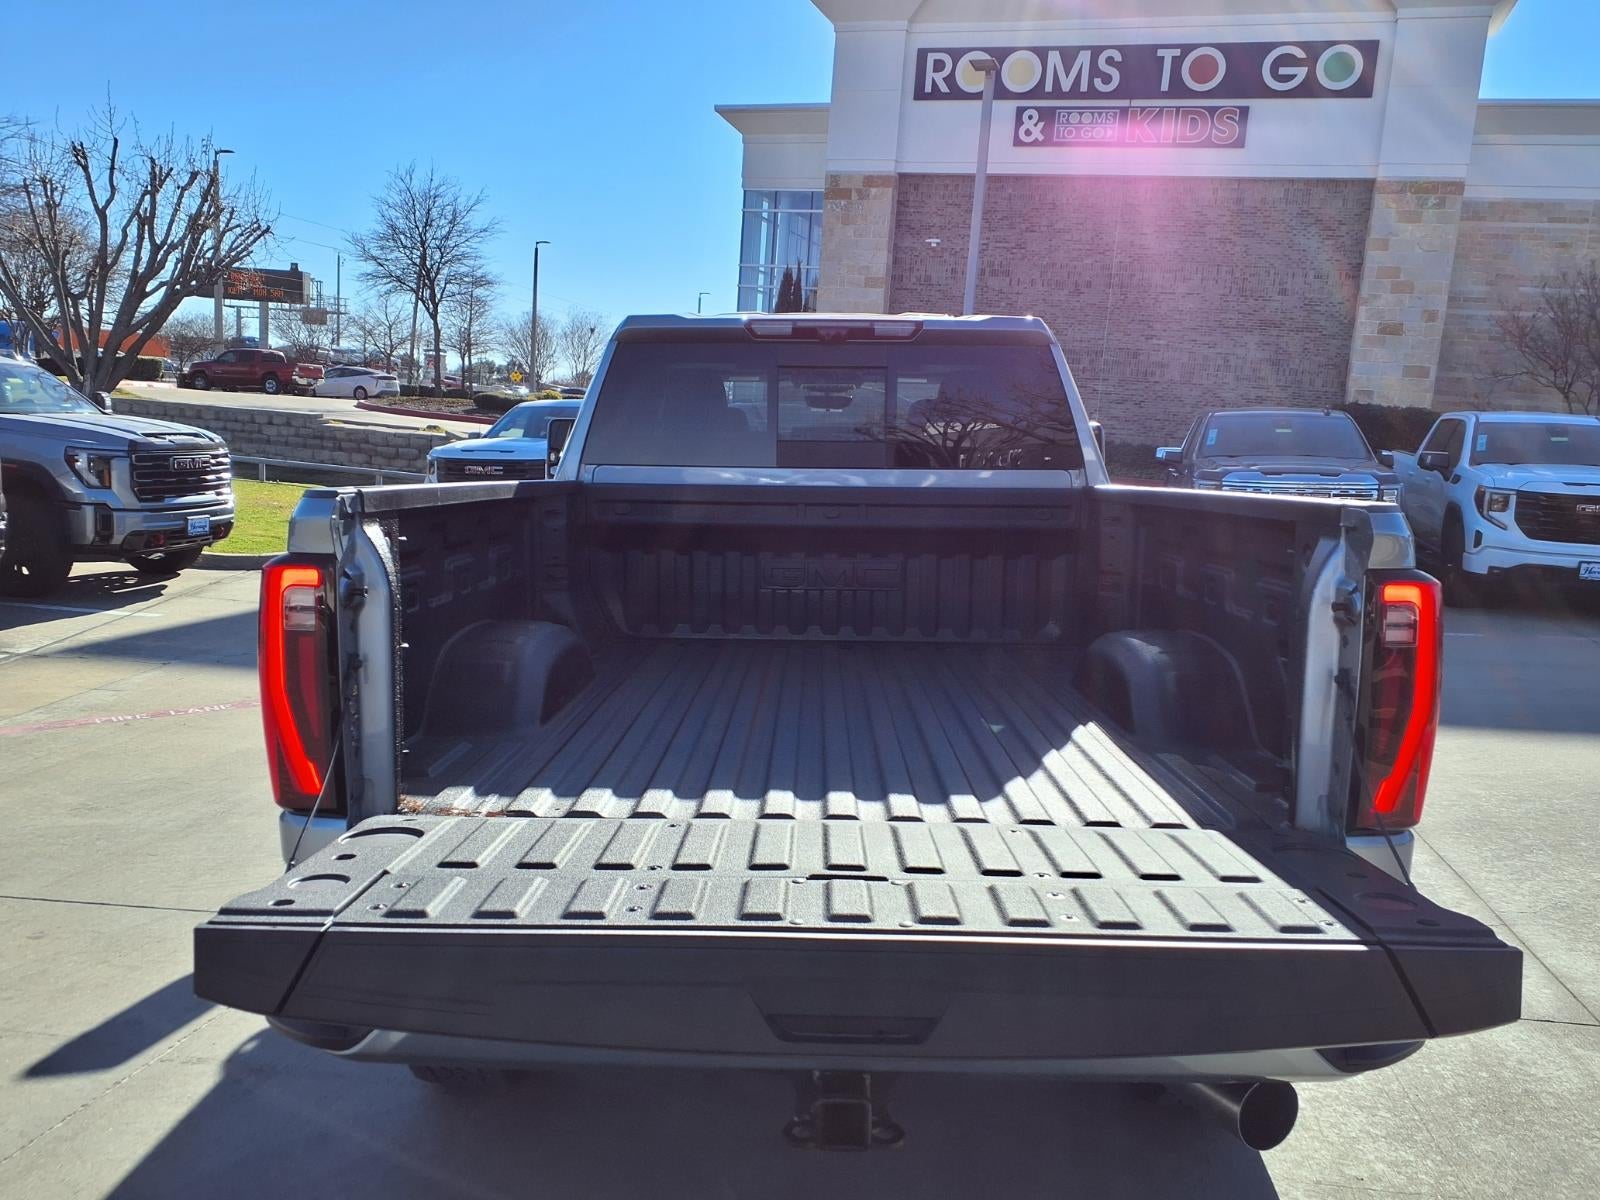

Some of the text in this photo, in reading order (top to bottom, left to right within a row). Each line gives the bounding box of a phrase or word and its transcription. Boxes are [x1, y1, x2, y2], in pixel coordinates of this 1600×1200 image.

[924, 43, 1364, 94] ROOMS TO GO
[1018, 108, 1045, 143] &
[1059, 112, 1114, 123] ROOMS
[1125, 107, 1240, 144] KIDS
[1058, 127, 1105, 139] TO GO
[464, 465, 504, 475] GMC
[760, 559, 903, 588] GMC
[95, 703, 232, 724] FIRE LANE
